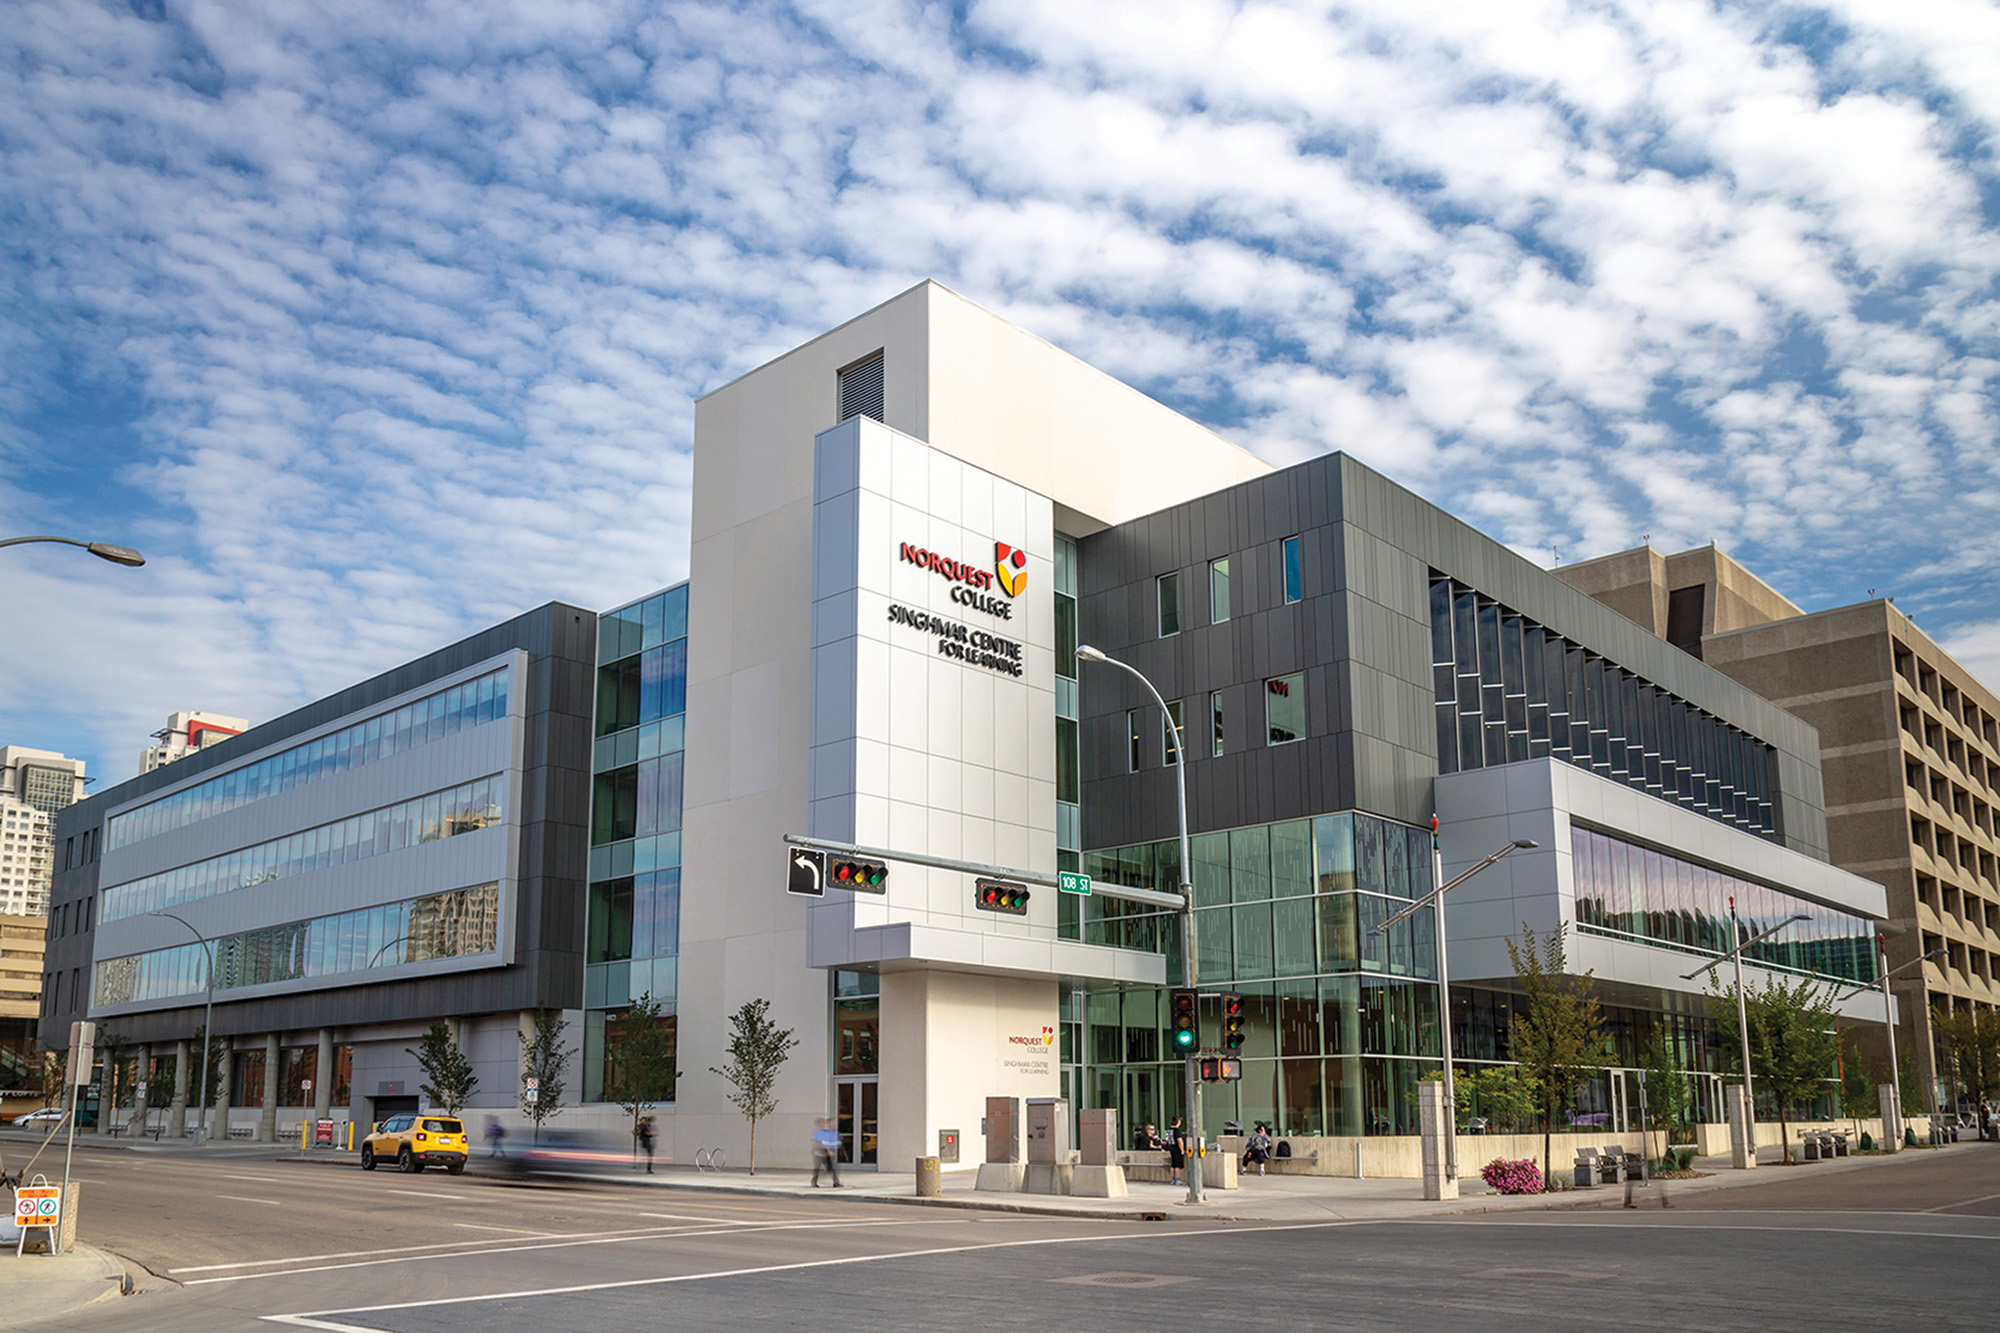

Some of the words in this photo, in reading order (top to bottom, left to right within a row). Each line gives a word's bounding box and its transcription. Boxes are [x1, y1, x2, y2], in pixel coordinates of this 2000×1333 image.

[900, 542, 994, 591] NORQUEST
[950, 586, 1012, 620] COLLEGE
[888, 604, 969, 643] SINGHMAR
[970, 631, 1022, 661] CENTRE
[939, 639, 964, 659] FOR
[965, 647, 1023, 678] LEARNING
[1063, 876, 1076, 889] 108
[1080, 878, 1088, 891] ST
[1009, 1036, 1042, 1046] NORQUEST
[1027, 1046, 1048, 1054] COLLEGE
